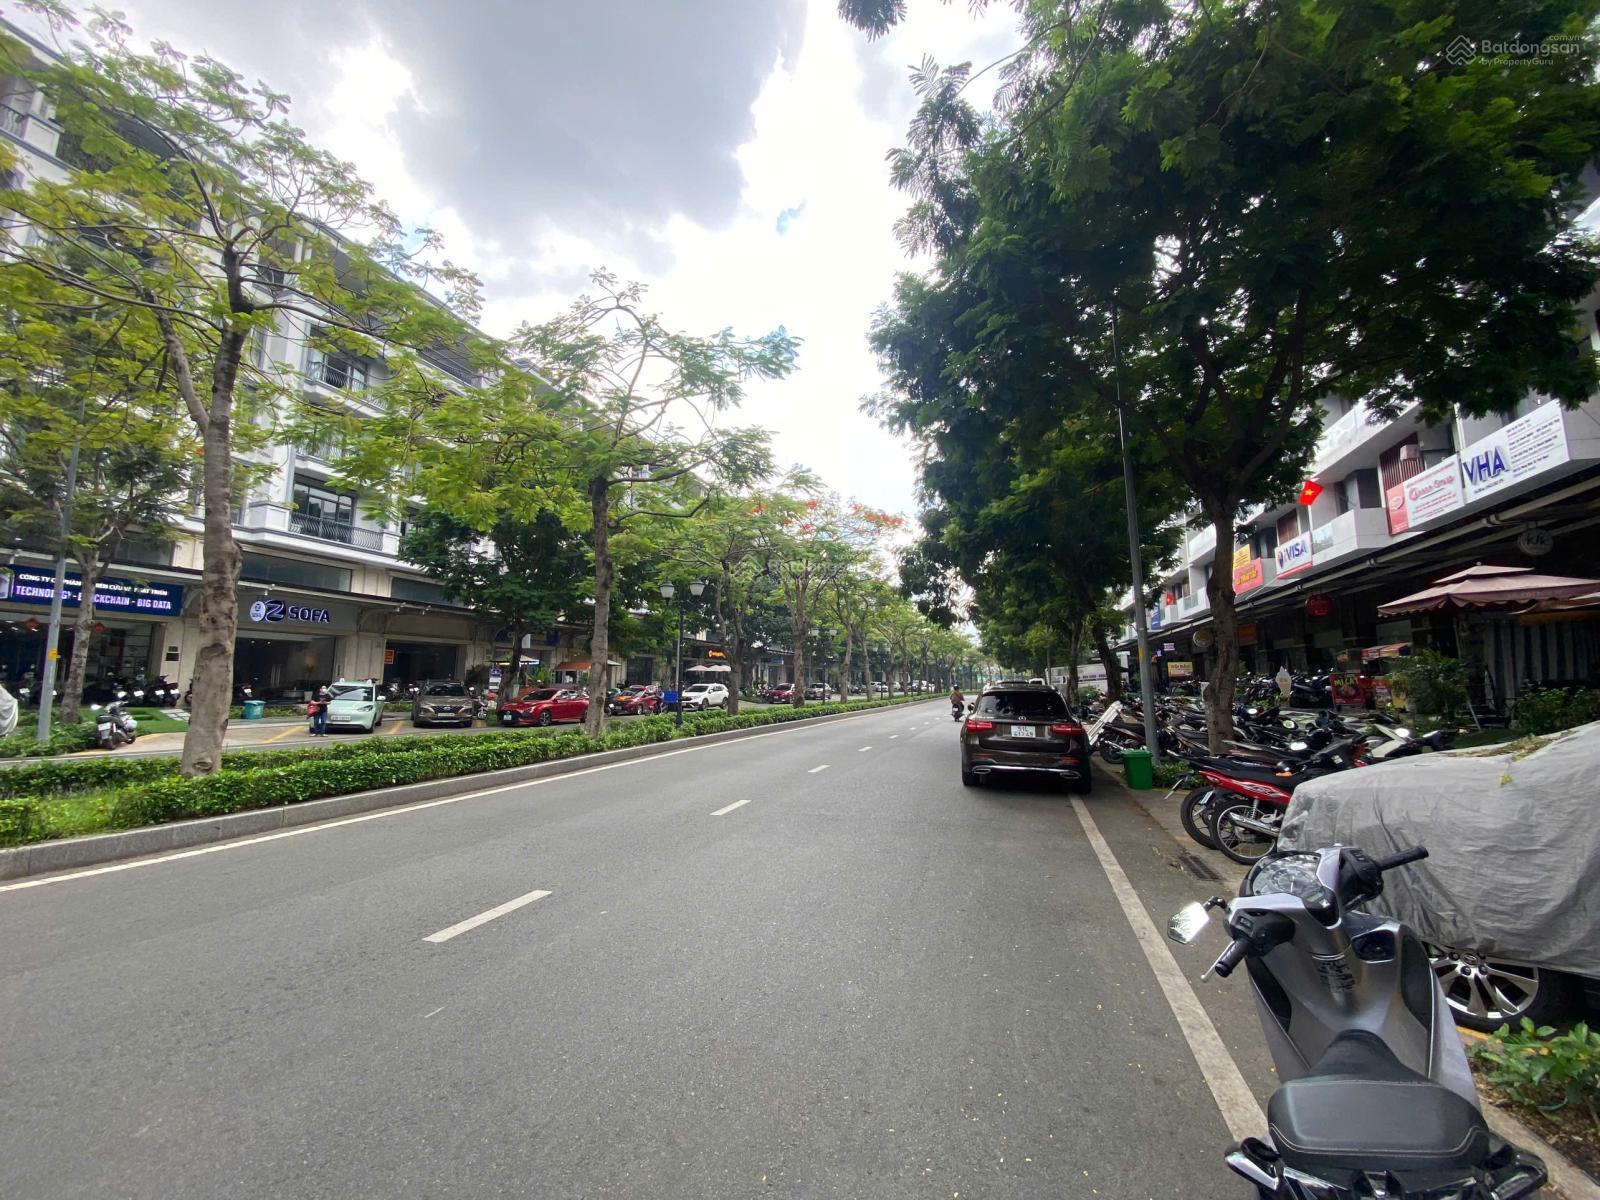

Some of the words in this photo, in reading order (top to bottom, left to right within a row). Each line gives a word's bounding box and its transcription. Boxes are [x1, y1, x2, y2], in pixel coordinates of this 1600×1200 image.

[1463, 447, 1506, 485] VHA
[137, 599, 152, 608] BIG
[152, 600, 171, 610] DATA
[288, 605, 330, 623] SOFA
